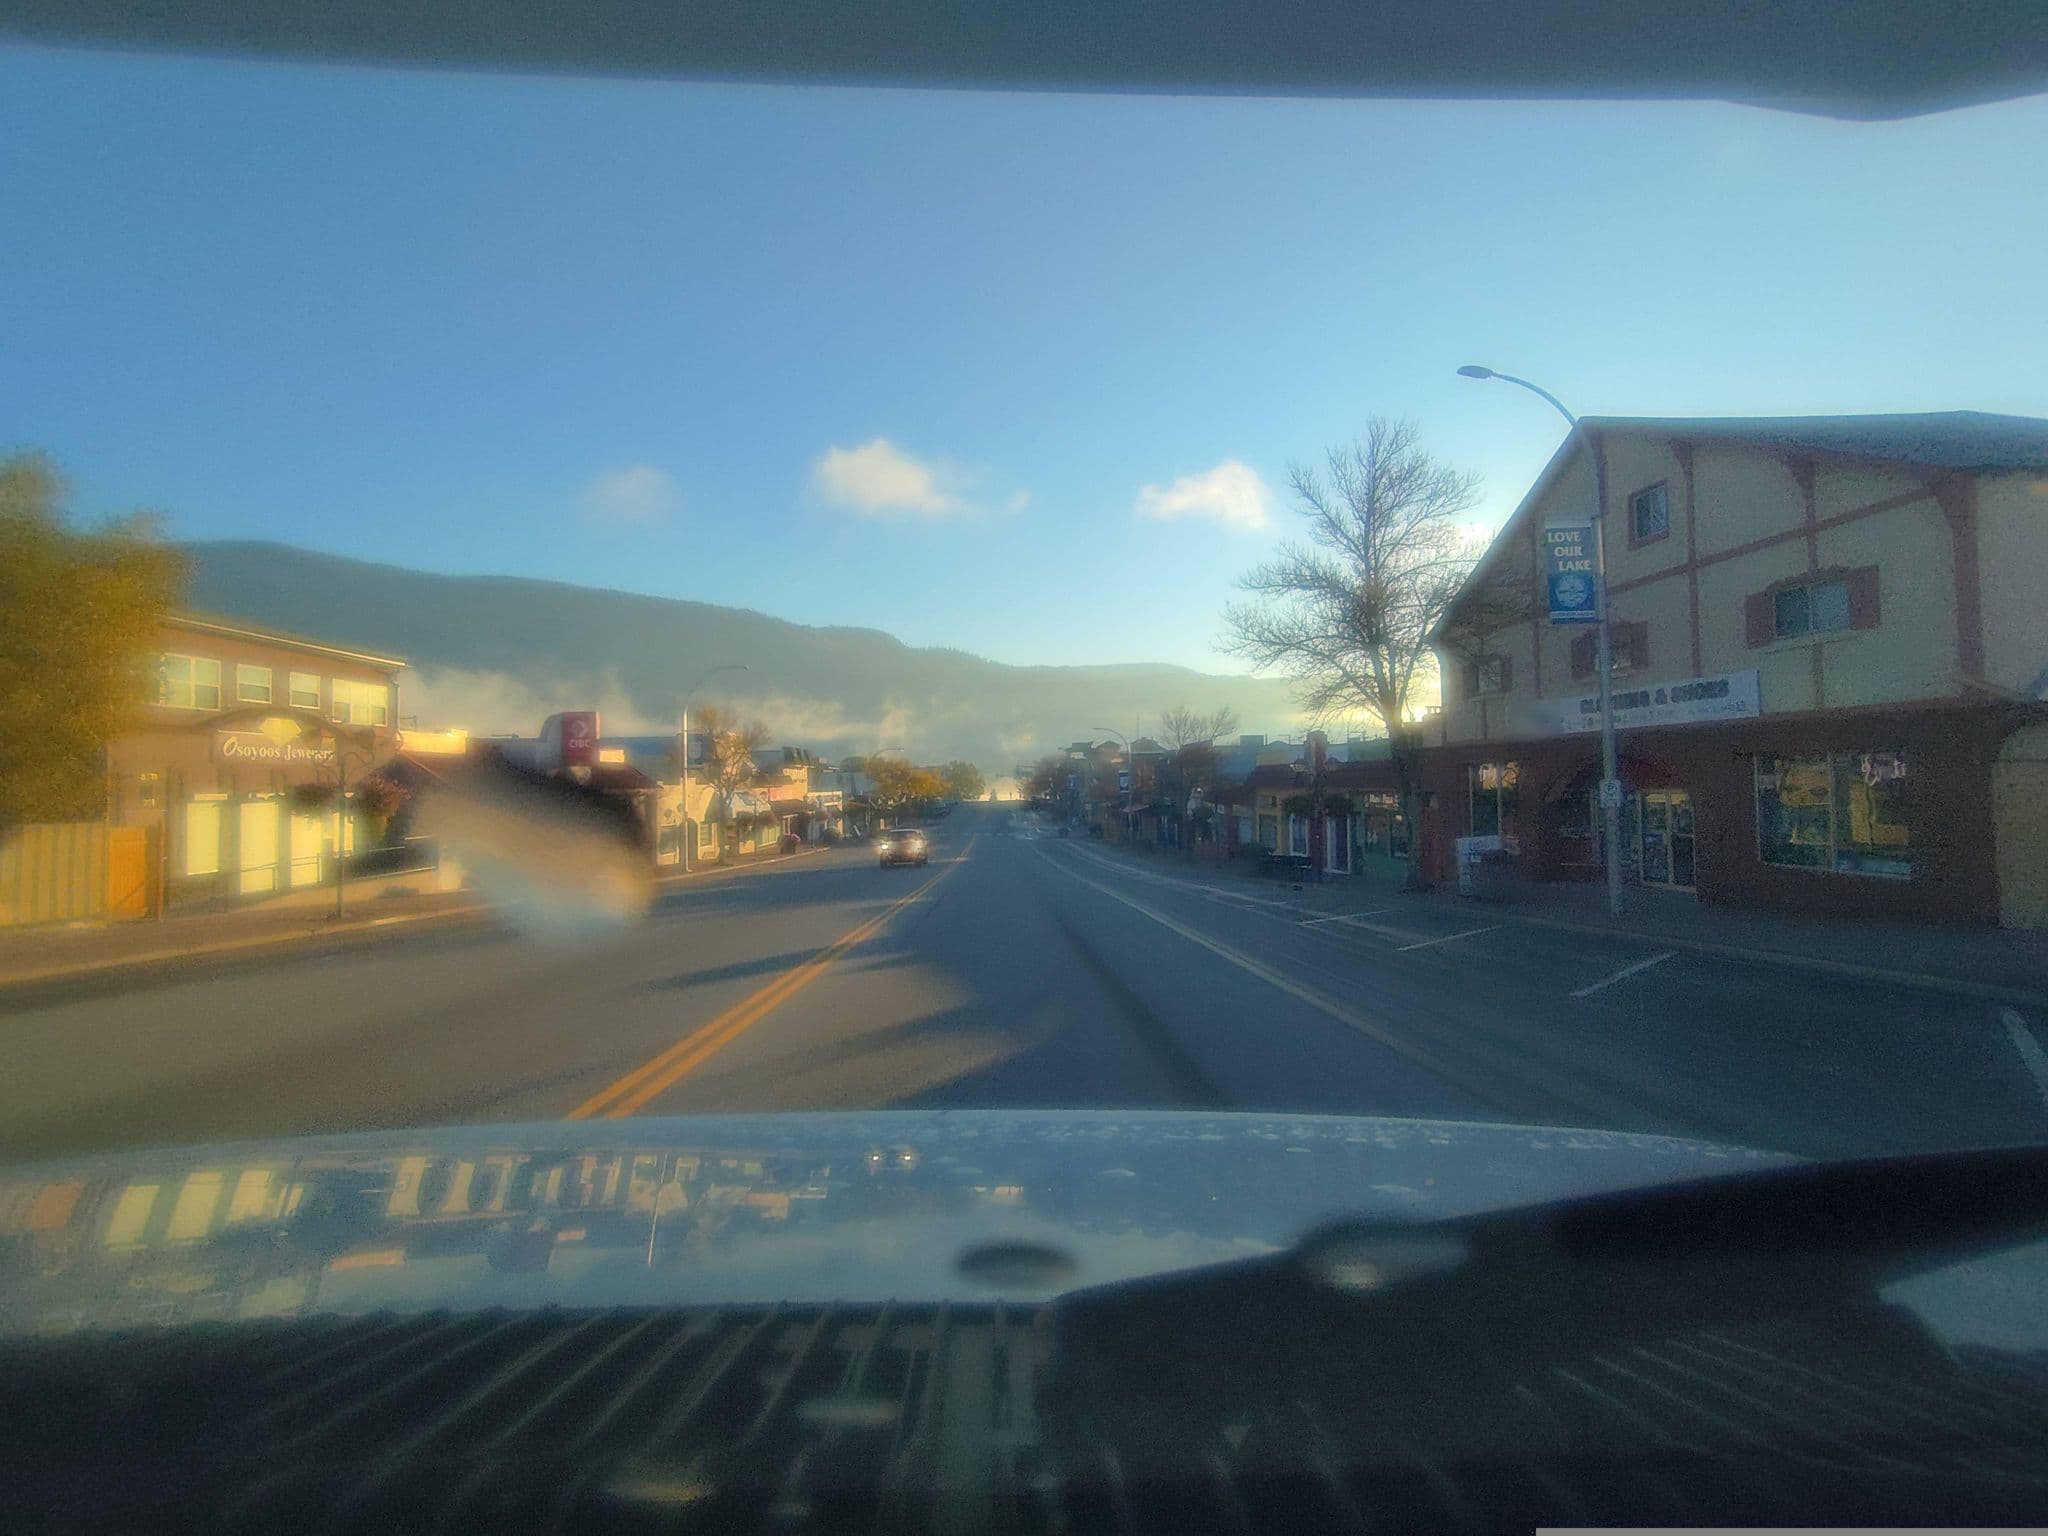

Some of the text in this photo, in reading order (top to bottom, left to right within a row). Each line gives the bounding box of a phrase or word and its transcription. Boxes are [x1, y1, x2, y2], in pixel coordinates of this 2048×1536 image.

[1548, 532, 1581, 543] LOVE
[1554, 546, 1583, 557] OUR
[1559, 560, 1592, 571] LAKE
[223, 736, 280, 760] Osoyoos
